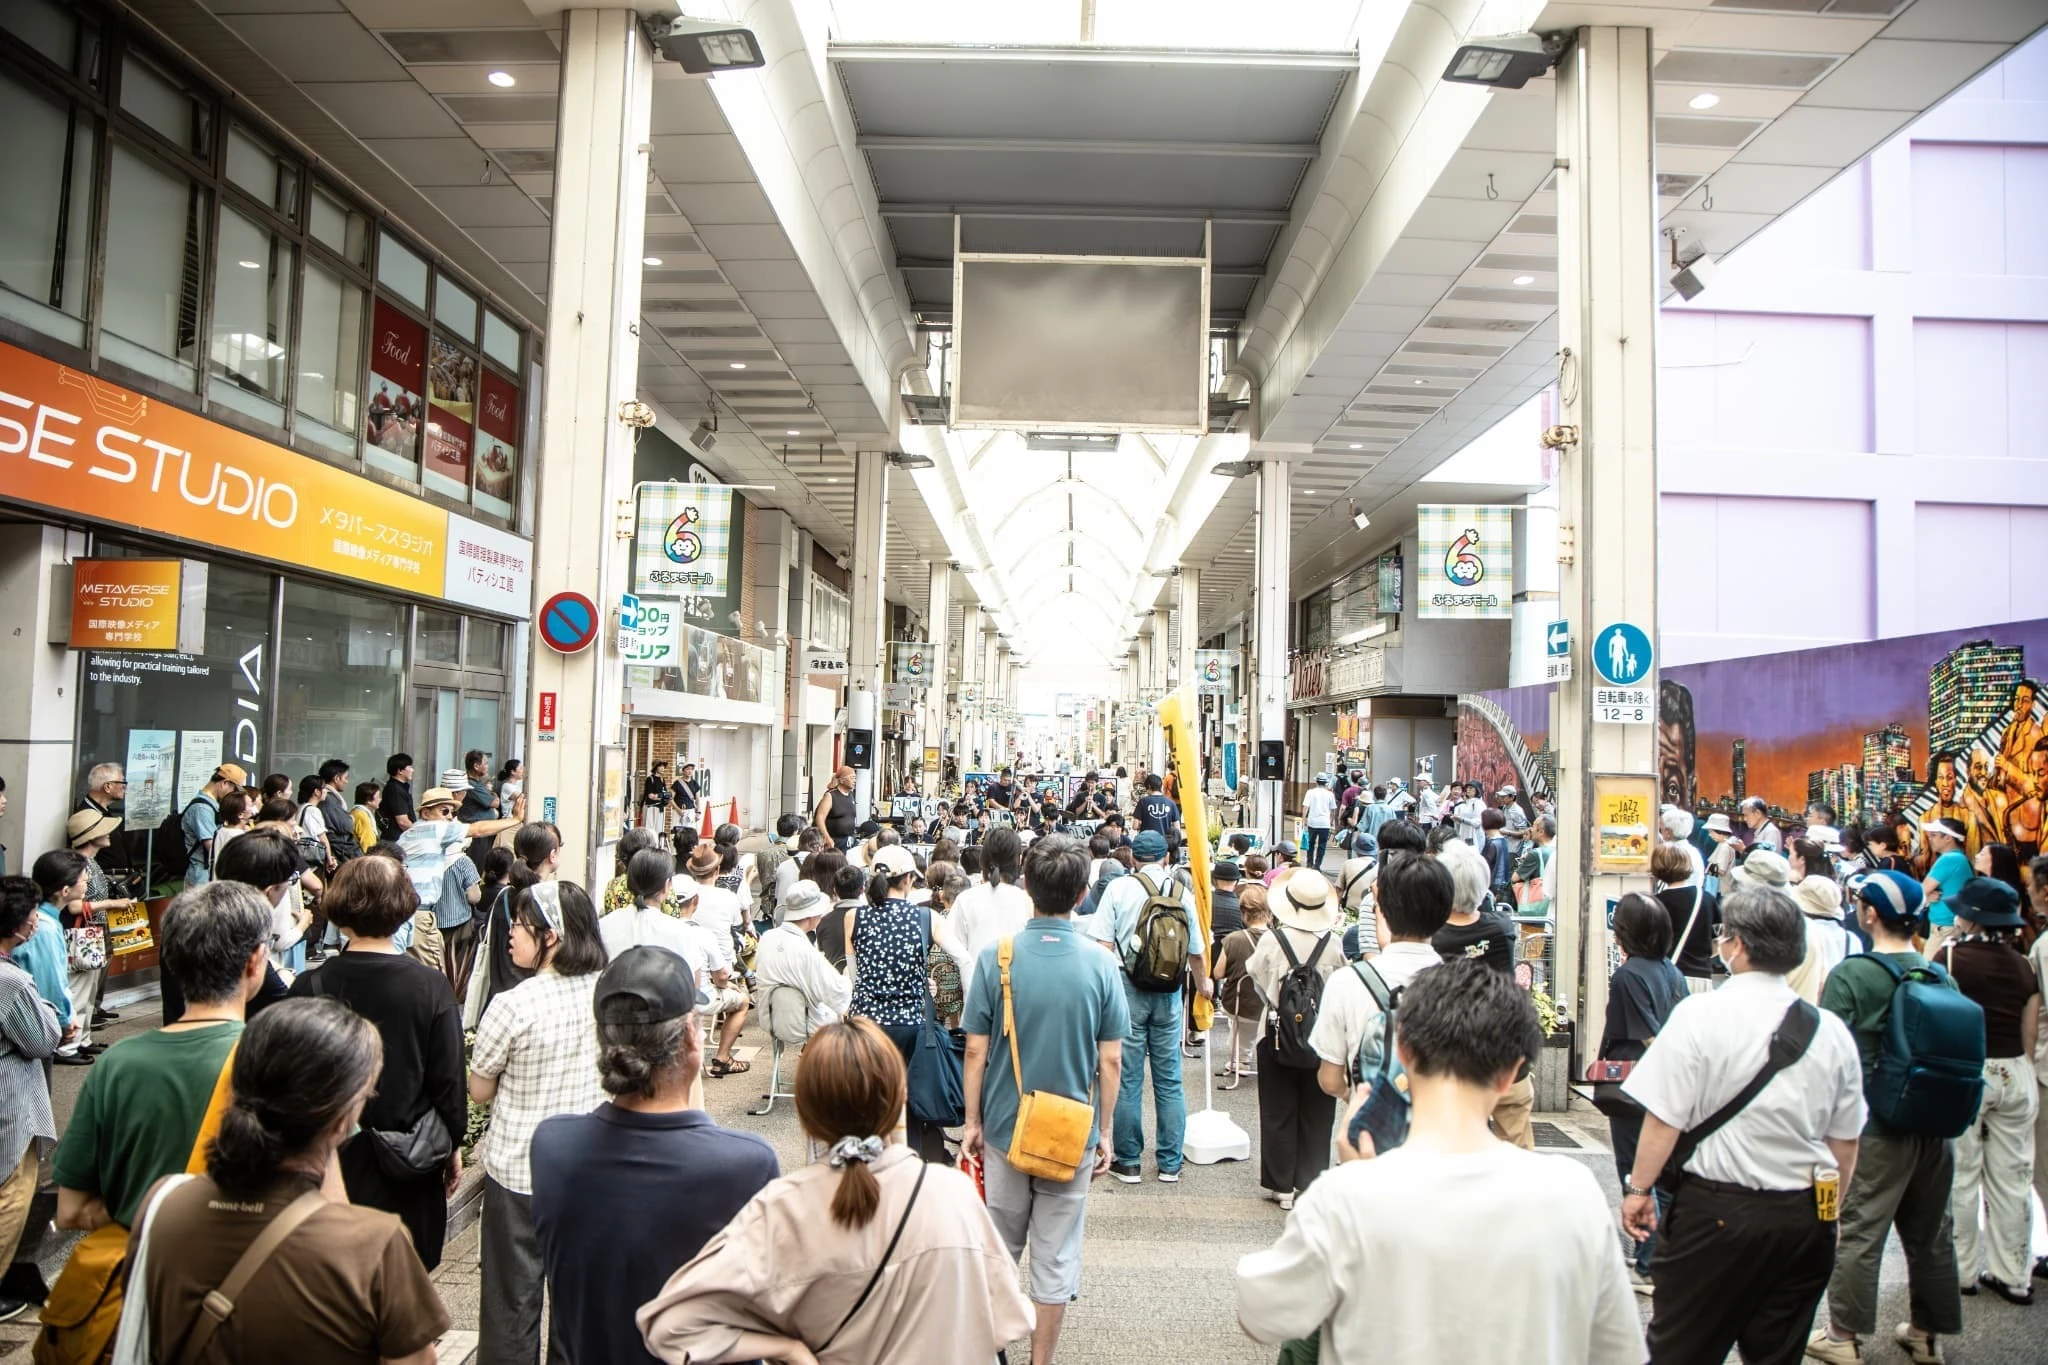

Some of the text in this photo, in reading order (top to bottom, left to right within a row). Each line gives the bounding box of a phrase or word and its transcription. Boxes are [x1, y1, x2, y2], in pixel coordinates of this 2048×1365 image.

[381, 331, 411, 366] Food
[88, 426, 298, 529] STUDIO
[319, 506, 433, 557] メタバーススタジオ
[650, 570, 714, 585] ふるまちモール
[80, 583, 170, 595] METAVERSE
[99, 597, 154, 608] STUDIO
[1432, 593, 1497, 606] ふるまちモール
[638, 607, 670, 623] 00円
[88, 619, 160, 630] 国際映像メディア
[638, 626, 669, 636] ョップ
[625, 644, 670, 660] リア
[90, 655, 121, 669] allowing
[122, 658, 133, 668] for
[133, 661, 161, 672] practical
[162, 663, 186, 675] training
[186, 665, 209, 676] tailored
[90, 672, 143, 685] to the industry.
[1598, 690, 1649, 704] 自転車を除く
[234, 644, 262, 786] DIA
[1619, 799, 1638, 813] JAZZ
